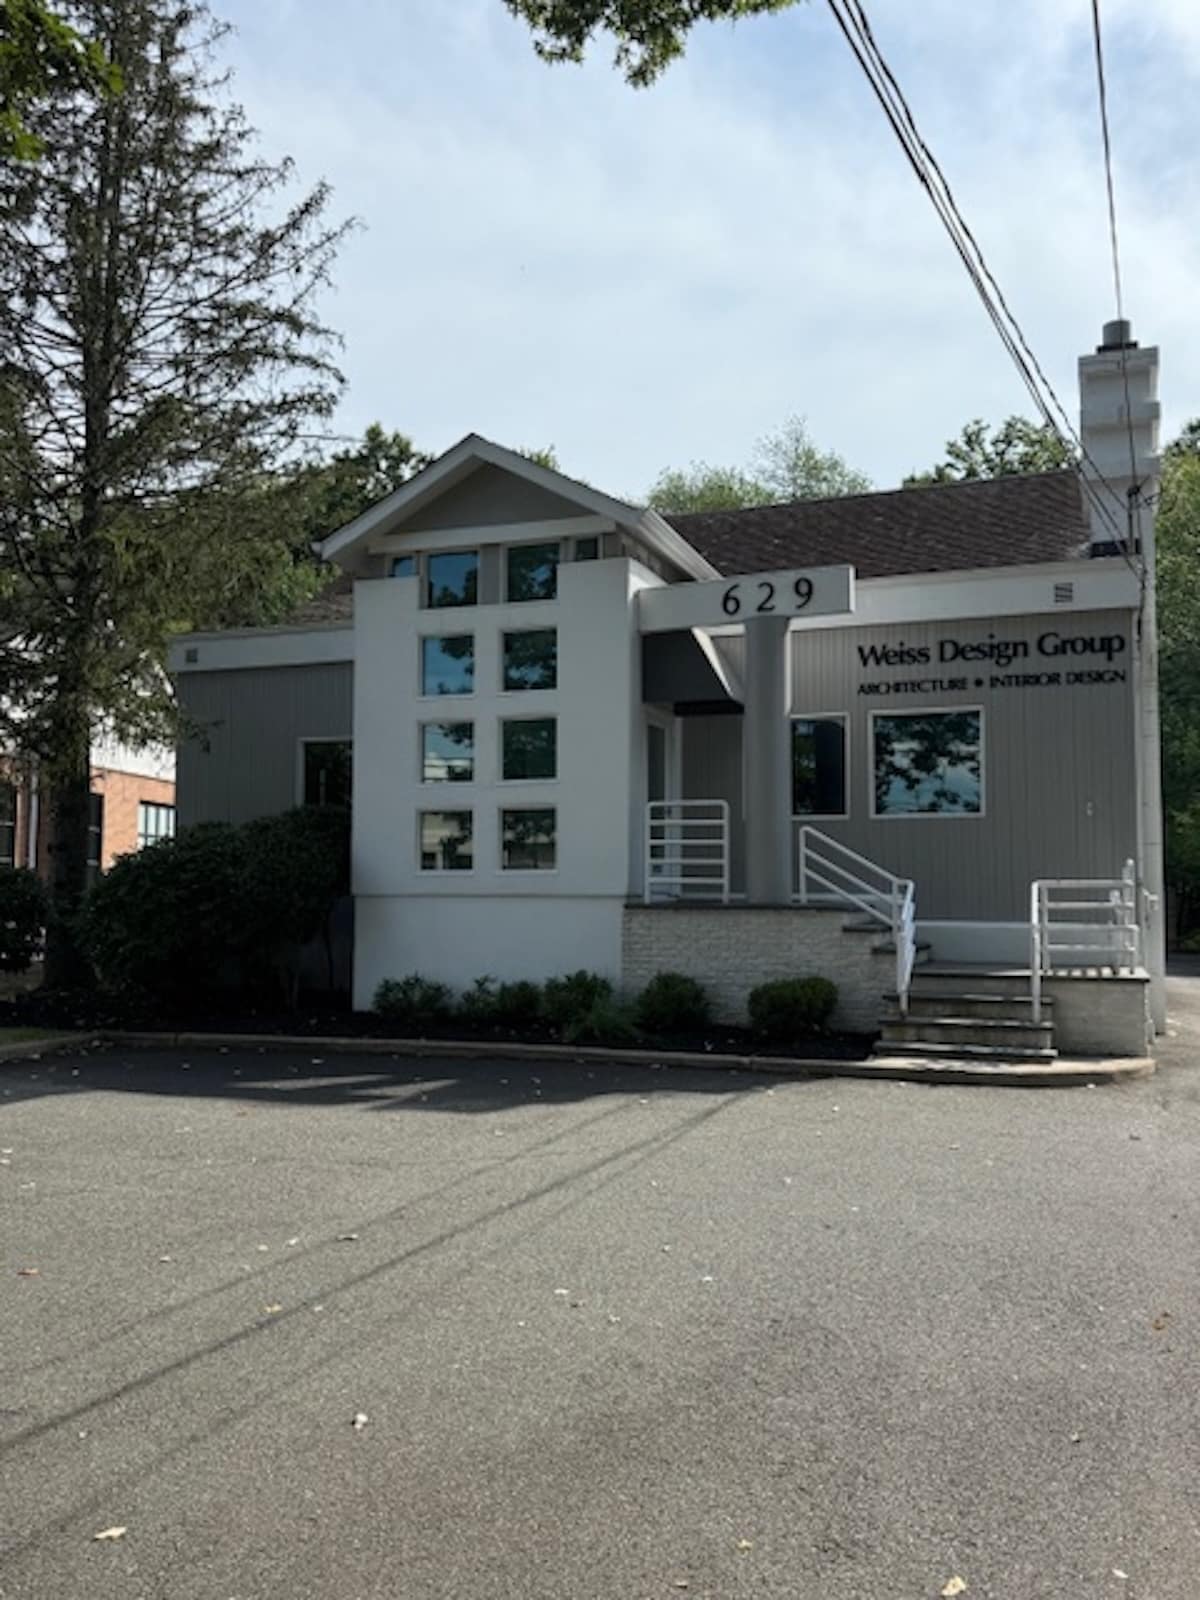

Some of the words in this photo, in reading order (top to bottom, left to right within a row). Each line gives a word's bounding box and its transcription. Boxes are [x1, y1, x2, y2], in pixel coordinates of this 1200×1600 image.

[722, 577, 813, 615] 629
[857, 641, 930, 667] Weiss
[938, 633, 1029, 667] Design
[1037, 632, 1125, 662] Group
[857, 677, 968, 695] ARCHITECTURE
[990, 671, 1062, 688] INTERIOR
[1065, 669, 1126, 685] DESIGN
